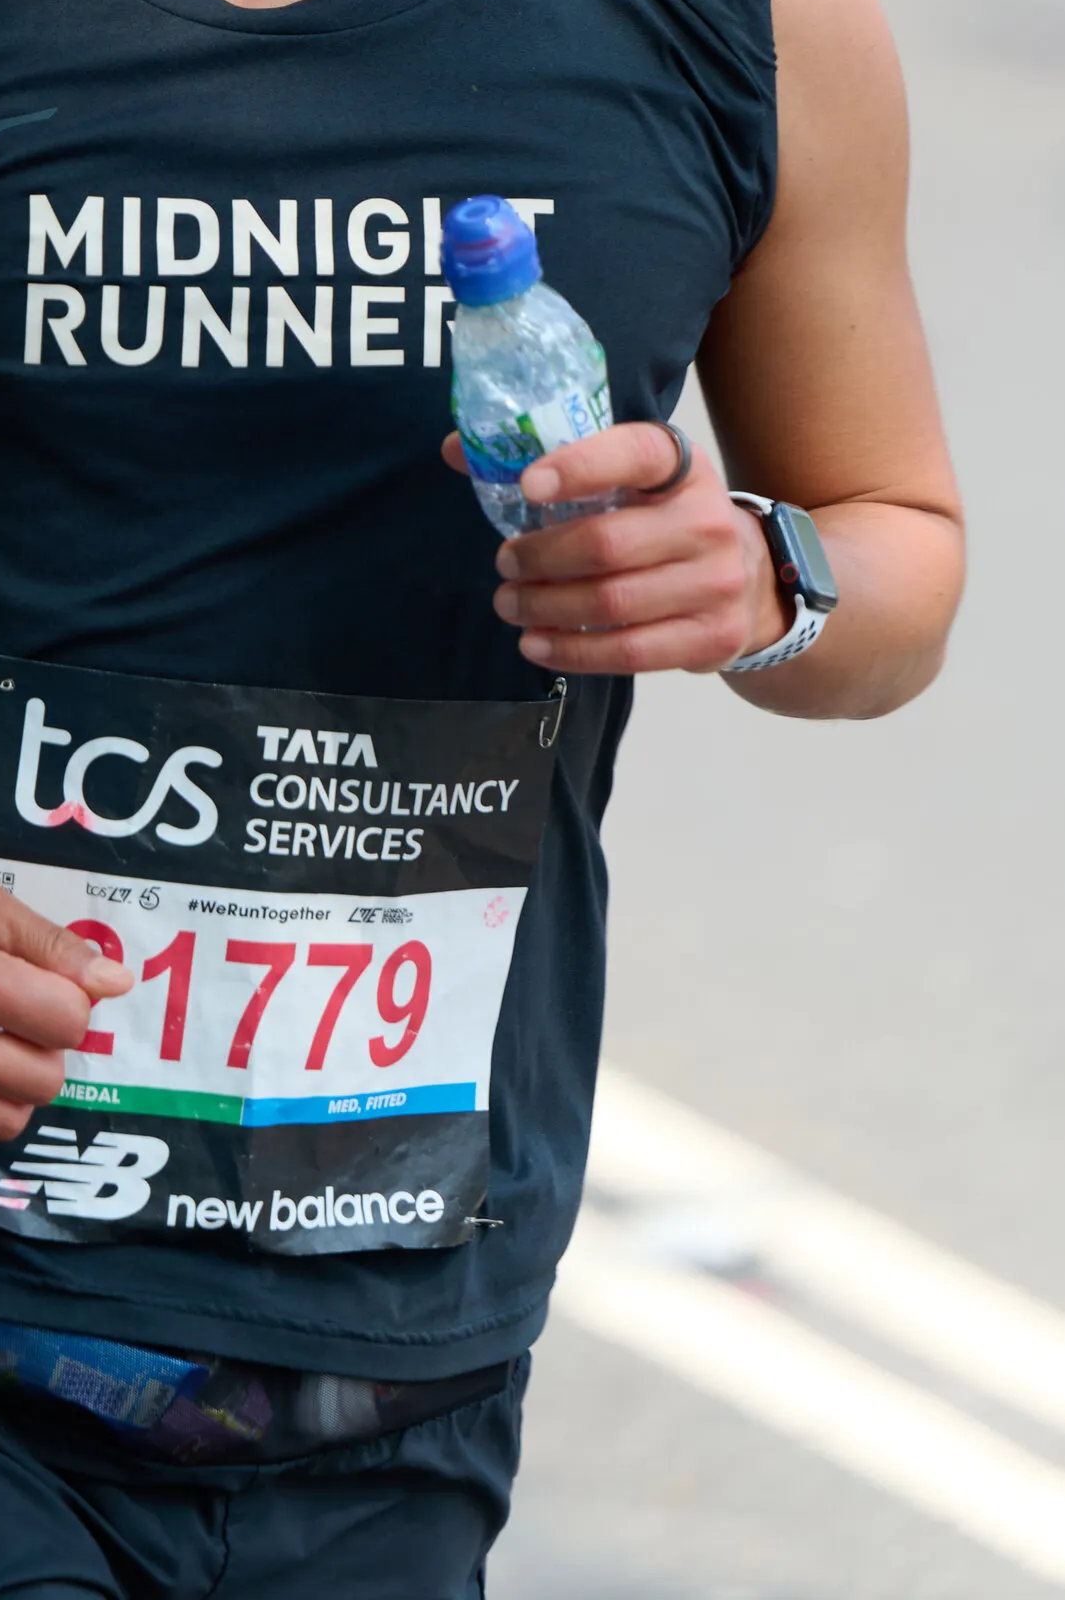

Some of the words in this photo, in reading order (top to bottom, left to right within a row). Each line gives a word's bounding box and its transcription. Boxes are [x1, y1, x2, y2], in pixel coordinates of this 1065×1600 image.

[27, 195, 555, 276] MIDNIG
[257, 725, 379, 768] TATA
[15, 697, 224, 846] tcs
[249, 773, 521, 816] CONSULTANCY
[243, 818, 425, 861] SERVICES
[188, 898, 332, 924] #WeRunTogether
[59, 1082, 121, 1105] MEDAL
[327, 1098, 361, 1114] MED,
[365, 1092, 407, 1111] FITTED
[166, 1193, 264, 1233] new
[269, 1186, 445, 1231] balance
